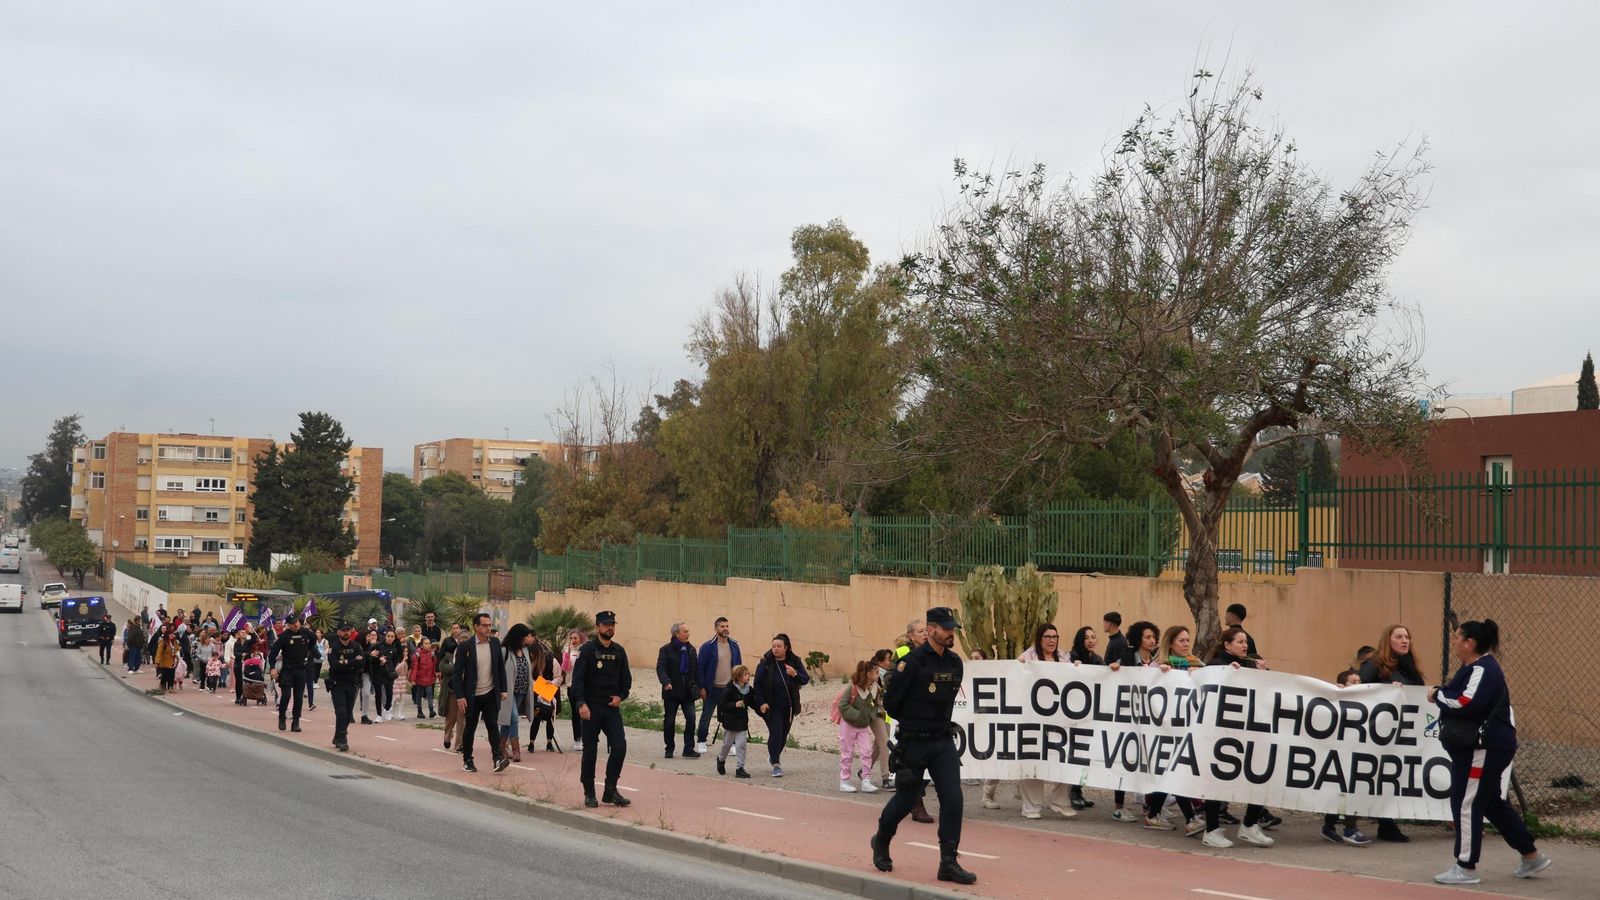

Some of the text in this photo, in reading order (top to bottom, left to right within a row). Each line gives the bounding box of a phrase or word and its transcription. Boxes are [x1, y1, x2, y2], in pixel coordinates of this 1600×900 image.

[972, 677, 1420, 746] EL COLEGIO INTELHORCE
[1170, 732, 1201, 777] A
[1210, 737, 1277, 785] SU
[1285, 745, 1452, 800] BARRIO
